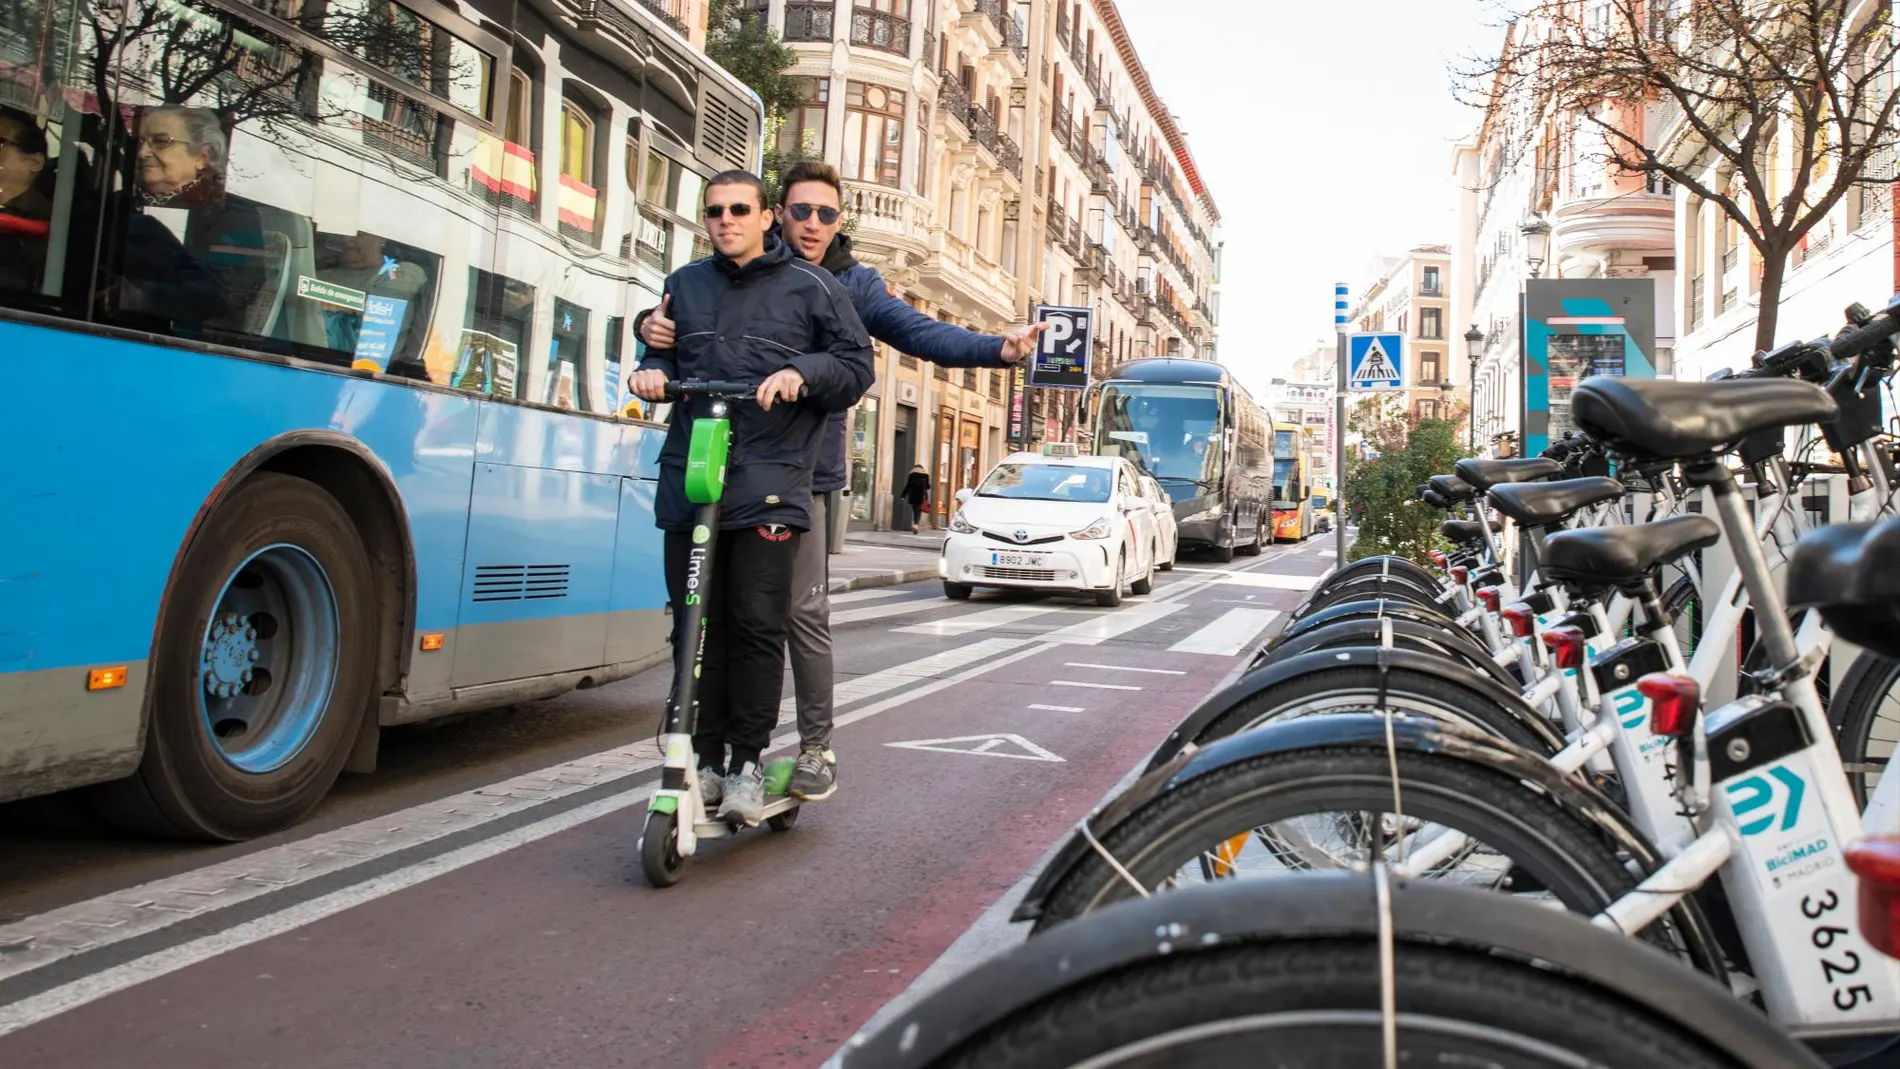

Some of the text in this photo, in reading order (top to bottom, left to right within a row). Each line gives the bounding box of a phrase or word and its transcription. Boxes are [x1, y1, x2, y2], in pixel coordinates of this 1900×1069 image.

[310, 284, 328, 294] Salida
[327, 289, 335, 297] de
[1043, 316, 1073, 353] P
[1000, 555, 1022, 565] 8902
[1765, 838, 1828, 872] BiciMAD
[1787, 856, 1835, 881] MADRID
[1801, 889, 1873, 1011] 3625
